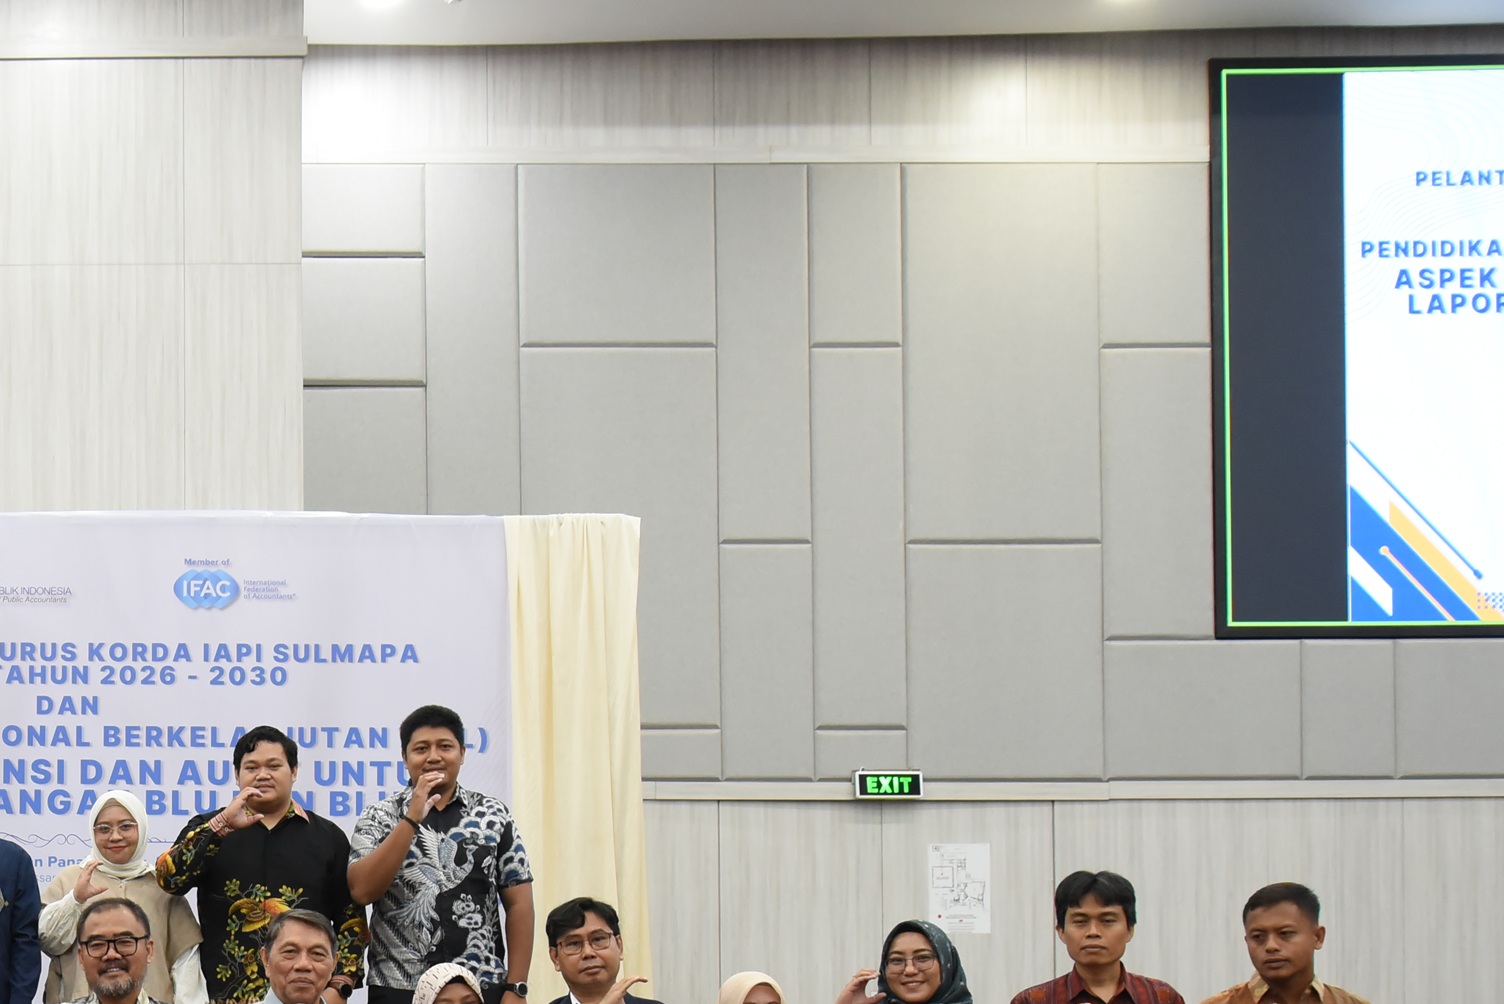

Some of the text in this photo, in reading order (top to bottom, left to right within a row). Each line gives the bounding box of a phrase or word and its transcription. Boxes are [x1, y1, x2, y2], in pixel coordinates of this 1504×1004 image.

[1395, 267, 1498, 289] ASPEK
[184, 558, 231, 566] Member of
[21, 587, 72, 596] INDONESIA
[182, 580, 231, 598] IFAC
[3, 595, 24, 603] Public
[25, 596, 67, 604] Accountants
[88, 643, 191, 662] KORDA
[203, 643, 263, 663] IAPI
[273, 643, 419, 664] SULMAPA
[101, 665, 176, 685] 2026
[210, 666, 288, 686] 2030
[37, 695, 99, 715] DAN
[103, 725, 388, 749] BERKELAUTAN
[80, 759, 162, 786] DAN
[314, 760, 410, 787] UNTU
[866, 776, 912, 793] EXIT
[145, 789, 217, 816] BLU
